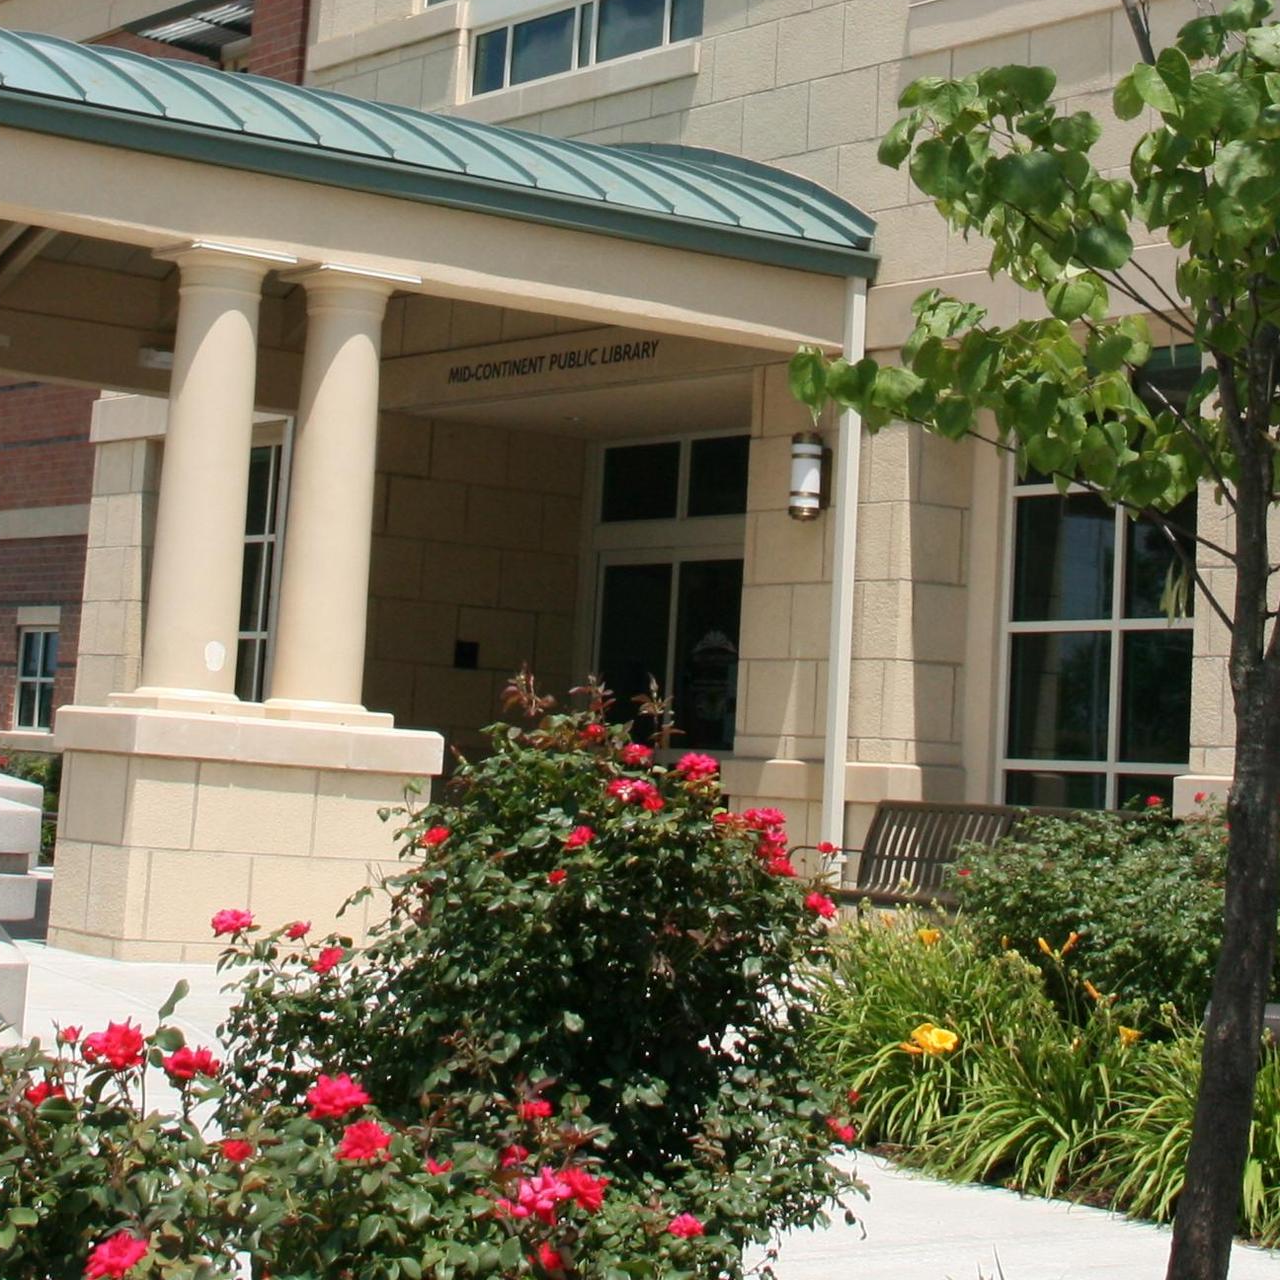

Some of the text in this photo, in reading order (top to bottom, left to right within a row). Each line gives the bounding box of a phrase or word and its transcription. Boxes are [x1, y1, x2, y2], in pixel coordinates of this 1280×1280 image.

[447, 339, 660, 384] MID-CONTINENT PUBLIC LIBRARY
